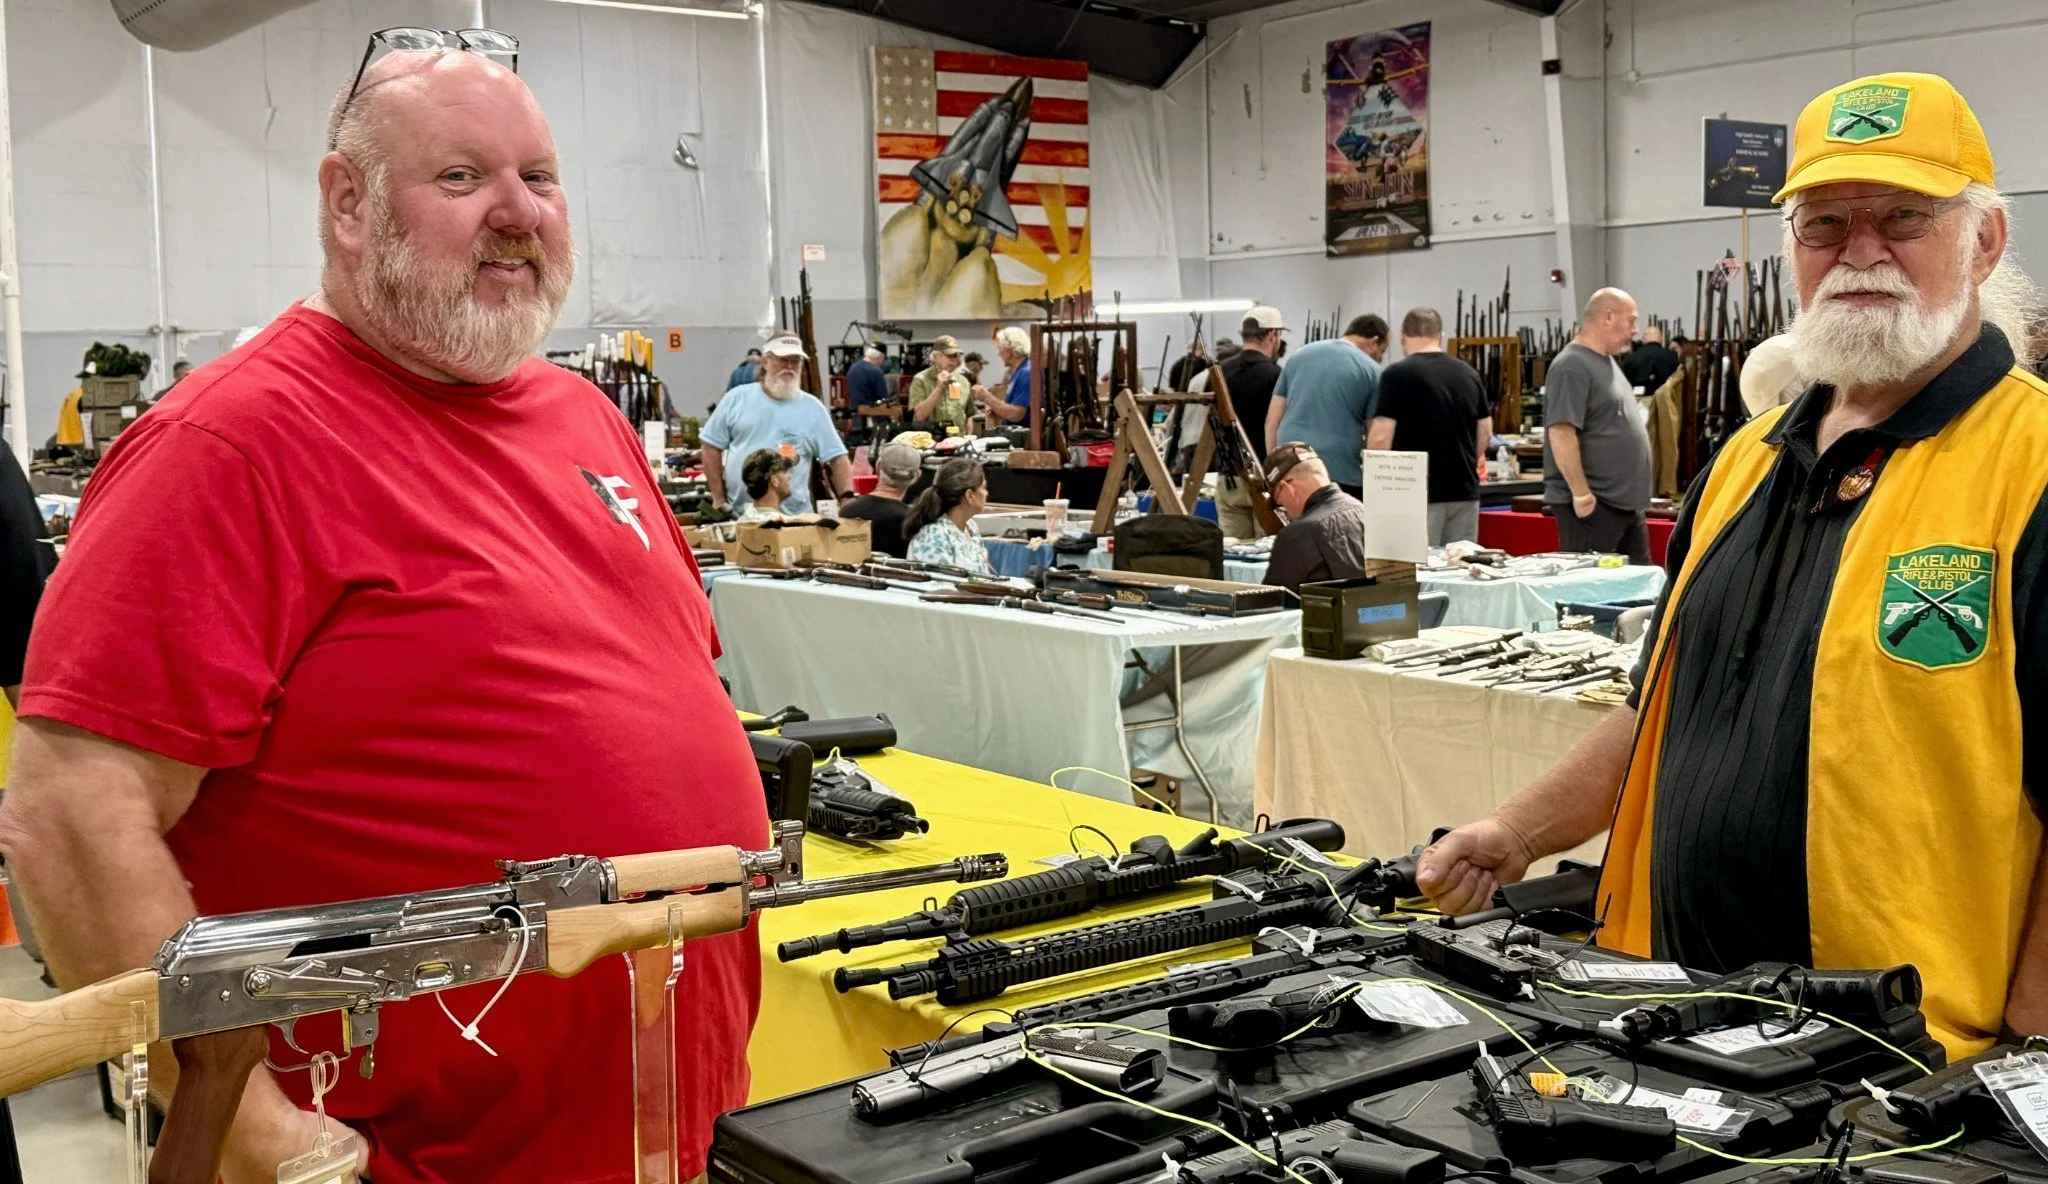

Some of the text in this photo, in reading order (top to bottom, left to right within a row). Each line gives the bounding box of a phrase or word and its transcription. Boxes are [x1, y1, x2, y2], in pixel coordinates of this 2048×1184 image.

[1842, 88, 1899, 99] LAKELAND
[670, 333, 681, 348] B
[1900, 554, 1981, 568] LAKELAND
[1918, 580, 1954, 591] CLUB
